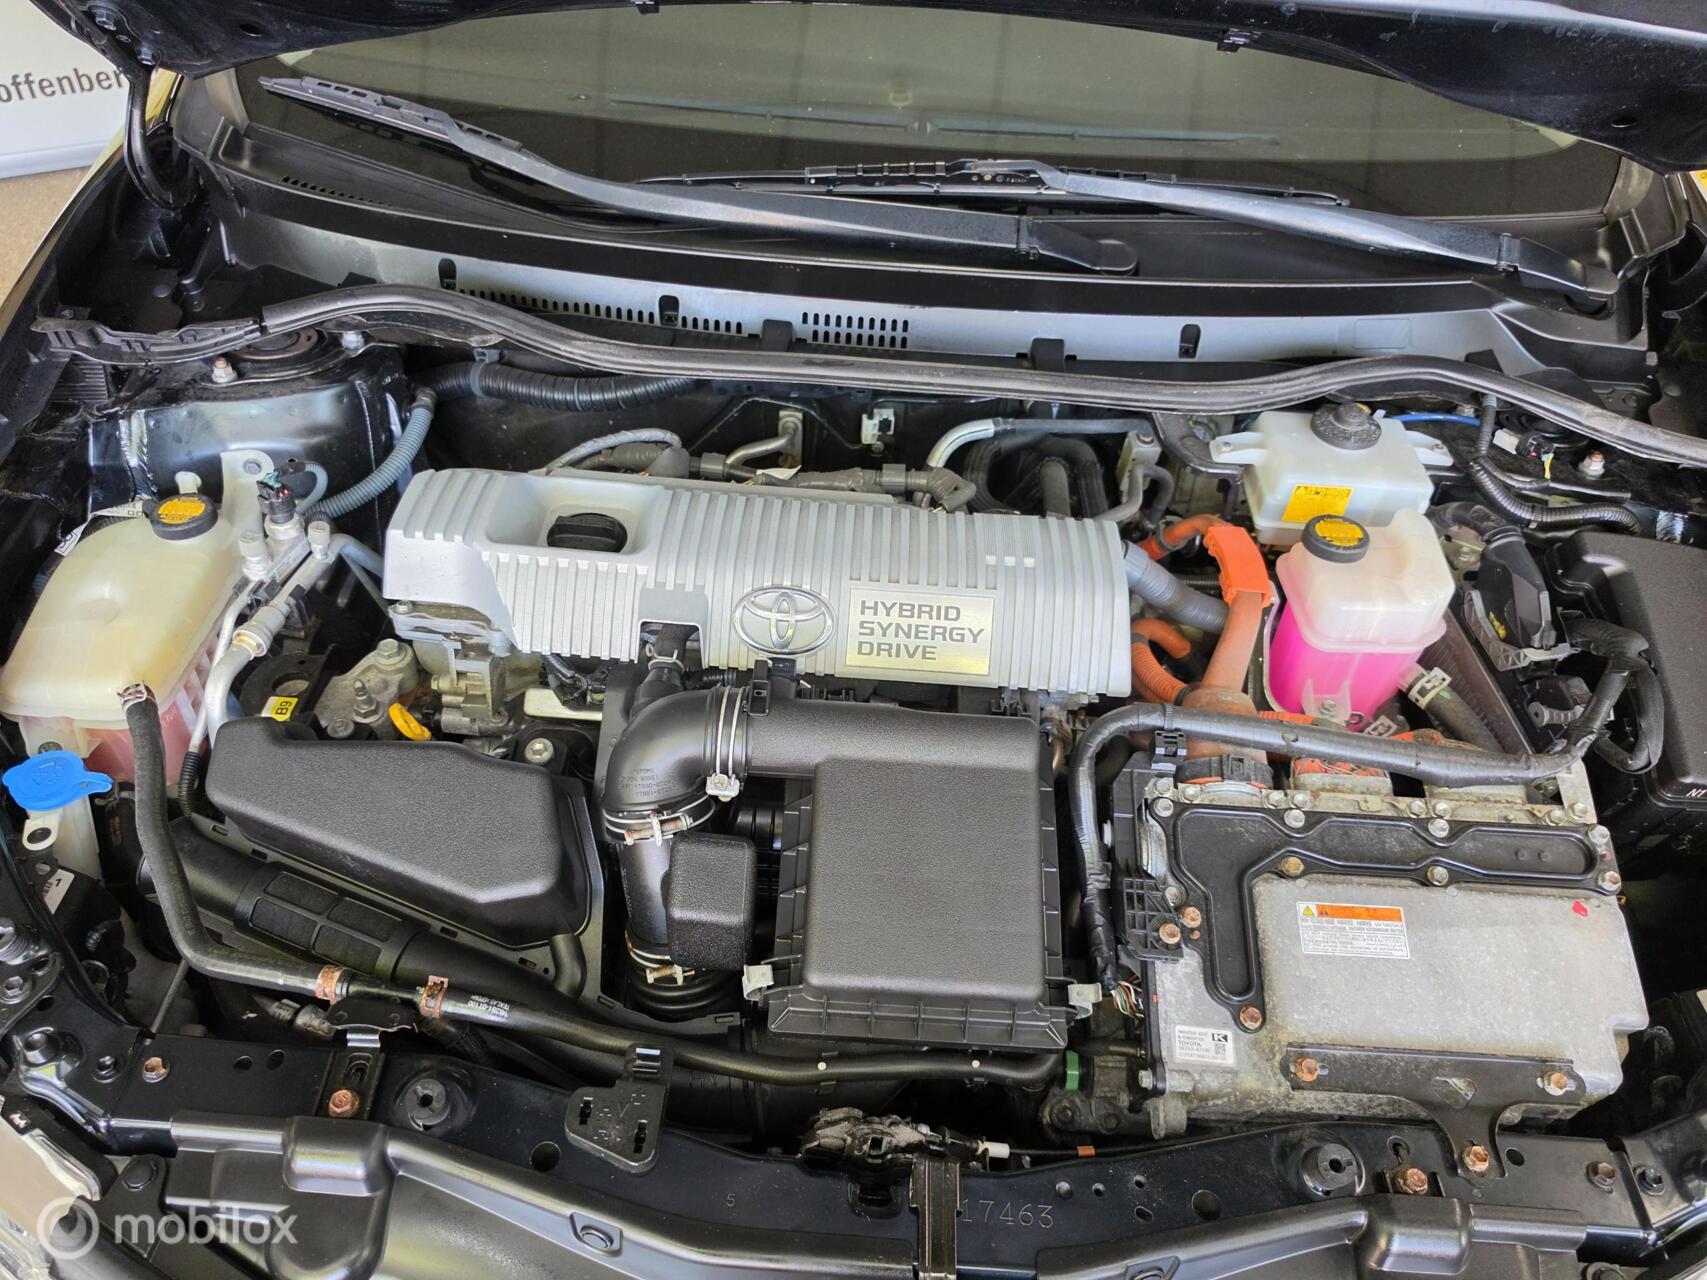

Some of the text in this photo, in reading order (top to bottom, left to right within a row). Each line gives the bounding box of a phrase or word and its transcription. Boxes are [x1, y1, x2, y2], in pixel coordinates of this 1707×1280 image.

[860, 600, 961, 621] HYBRID
[858, 620, 985, 643] SYNERGY
[857, 641, 937, 660] DRIVE
[962, 1199, 1054, 1229] 17463
